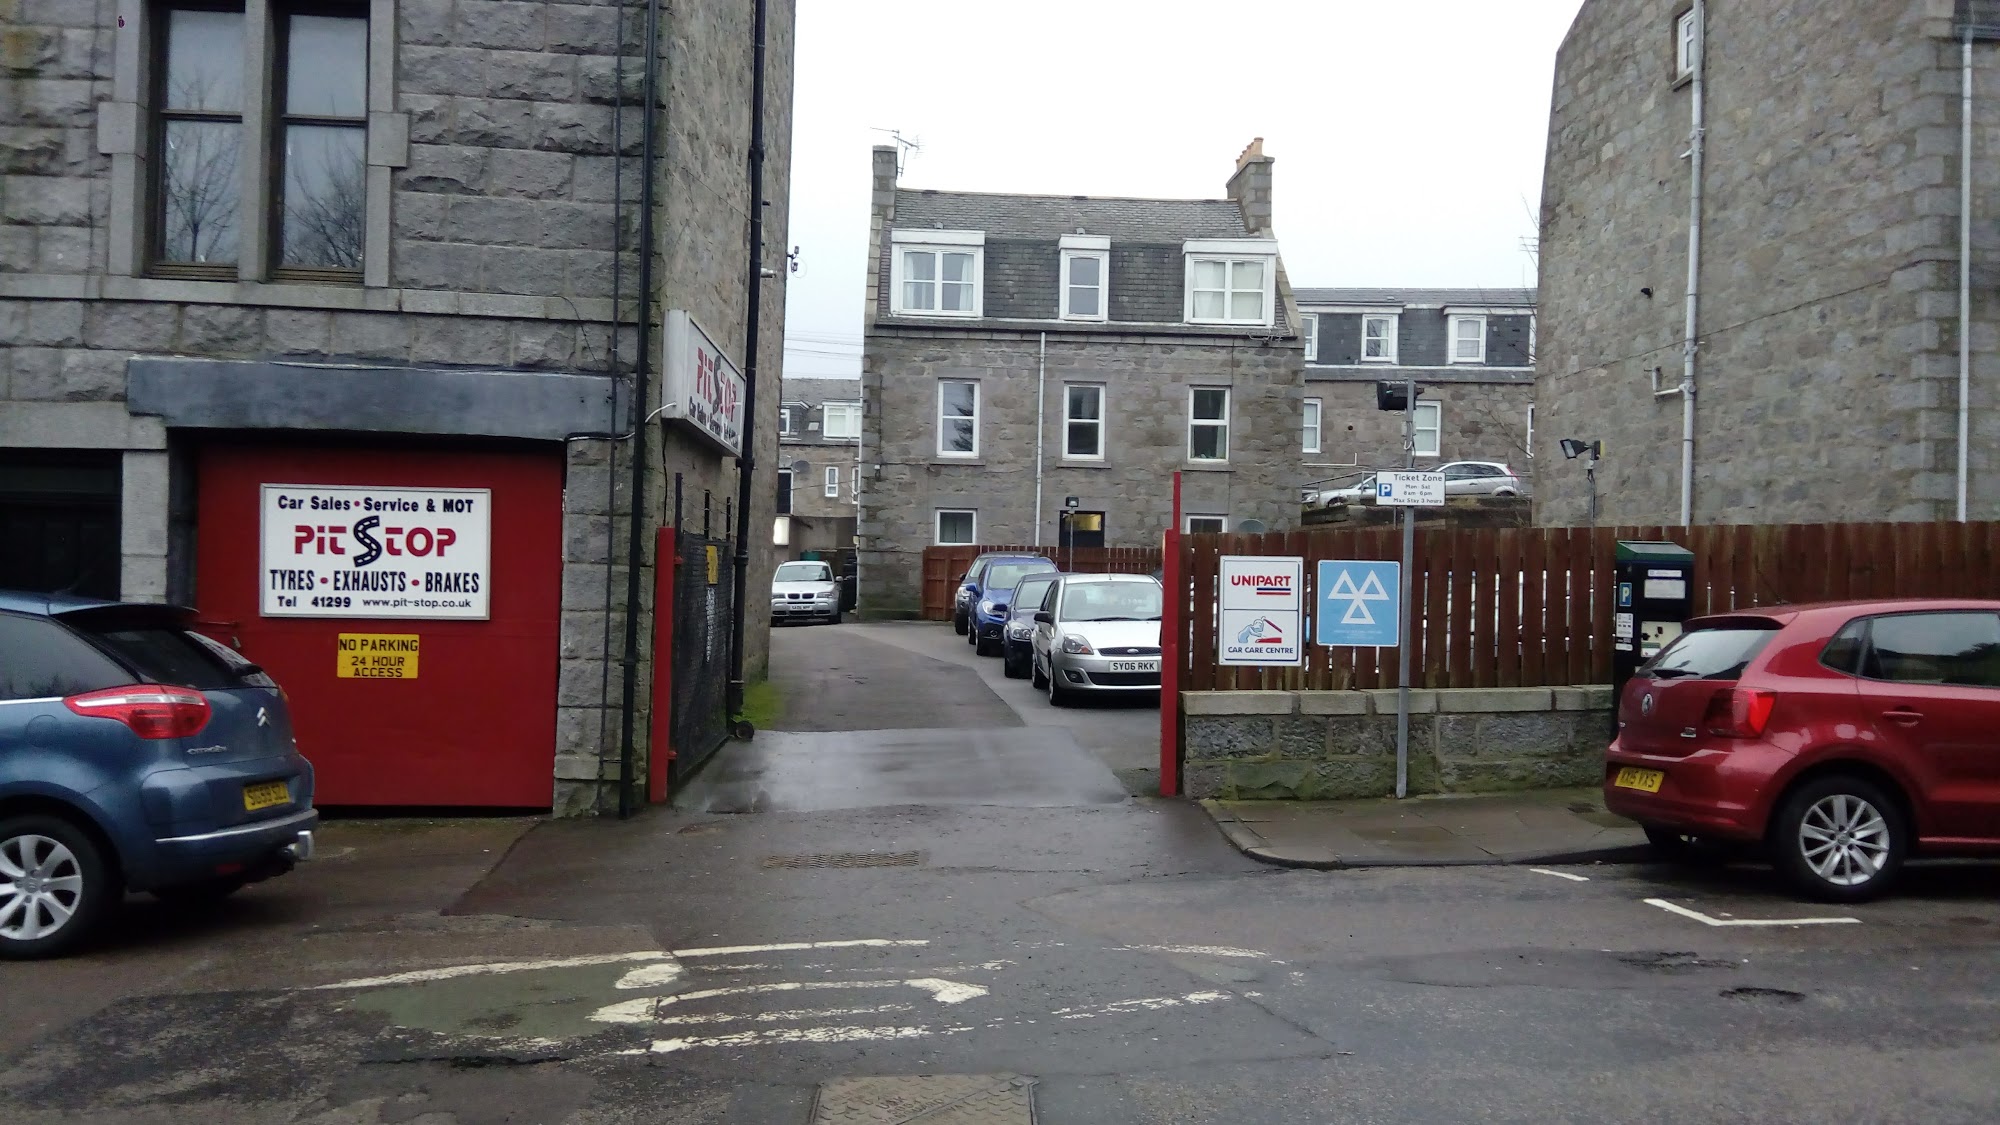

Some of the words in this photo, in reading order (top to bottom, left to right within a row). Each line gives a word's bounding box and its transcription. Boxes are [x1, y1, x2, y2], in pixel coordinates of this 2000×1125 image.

[1381, 484, 1391, 496] P
[278, 495, 304, 510] Car
[311, 496, 350, 510] Sales
[363, 497, 419, 512] Service
[426, 499, 435, 512] &
[443, 499, 473, 513] MOT
[270, 569, 315, 591] TYRES
[333, 570, 406, 592] EXHAUSTS
[425, 571, 479, 593] BRAKES
[1231, 575, 1291, 586] UNIPART
[1622, 586, 1630, 602] P
[277, 596, 297, 607] Tel
[311, 596, 351, 608] 41299
[362, 598, 471, 609] www.pit-stop.co.uk
[339, 639, 357, 651] NO
[360, 639, 419, 652] PARKING
[1228, 646, 1242, 654] CAR
[351, 656, 366, 666] 24
[372, 656, 405, 667] HOUR
[1138, 662, 1155, 671] RKK
[353, 668, 403, 678] ACCESS
